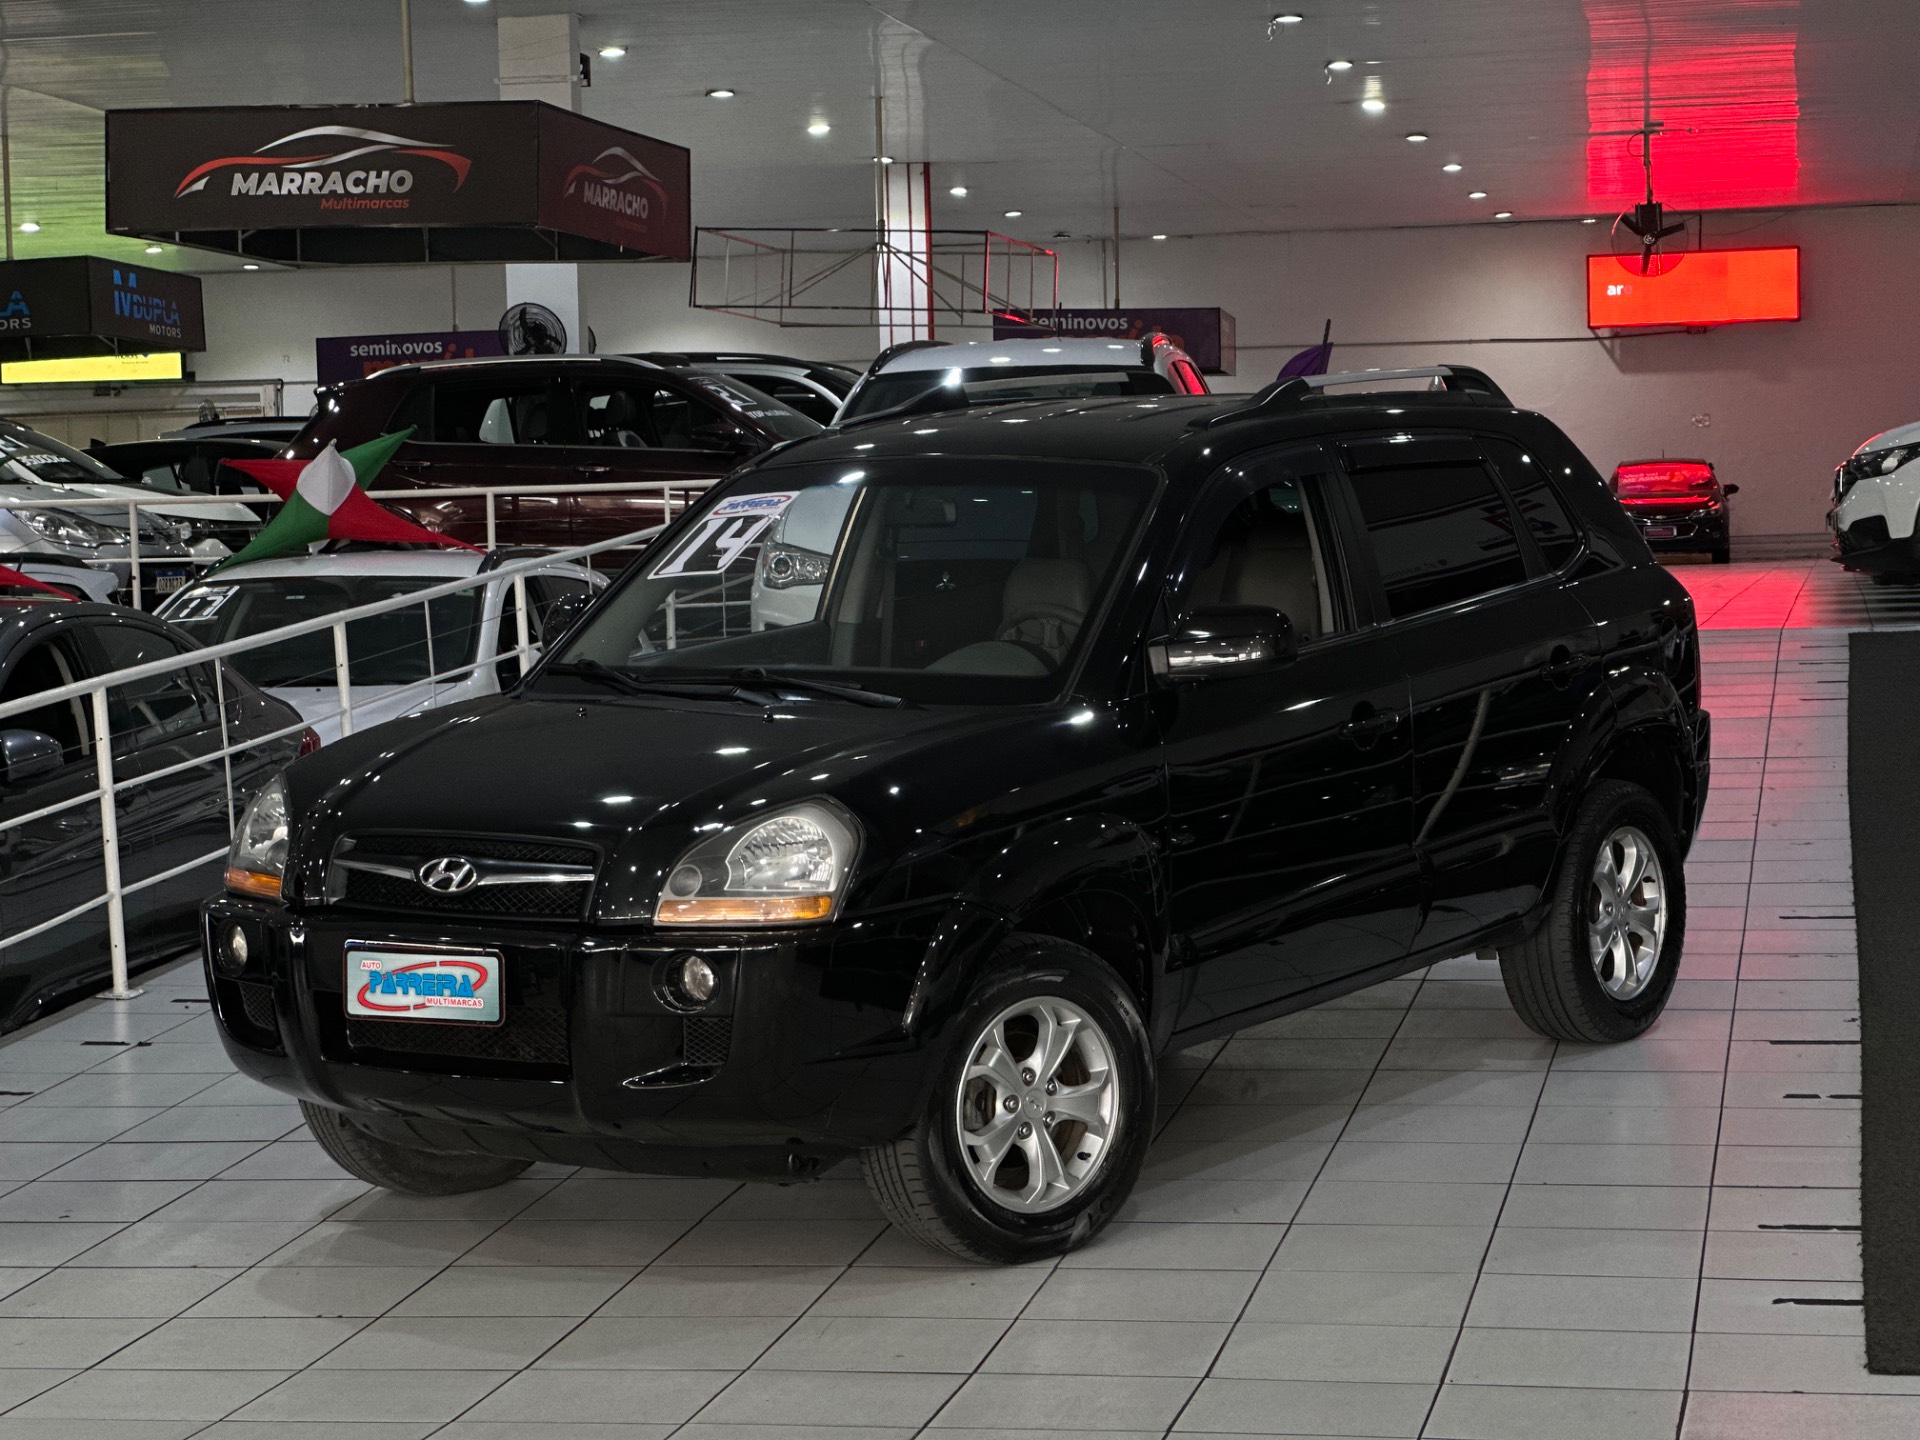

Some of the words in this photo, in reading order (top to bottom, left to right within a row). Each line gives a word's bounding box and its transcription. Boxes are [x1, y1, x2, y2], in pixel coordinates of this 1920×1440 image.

[230, 170, 414, 196] MARRACHO
[320, 197, 409, 210] Multimarcas
[583, 181, 649, 219] MARRACHO
[149, 323, 182, 339] MOTORS
[350, 340, 443, 357] seminovos
[658, 517, 770, 575] 14
[179, 595, 225, 618] 17
[361, 961, 381, 969] AUTO
[369, 971, 474, 998] PARREIRA
[426, 997, 483, 1008] MULTIMARCAS
